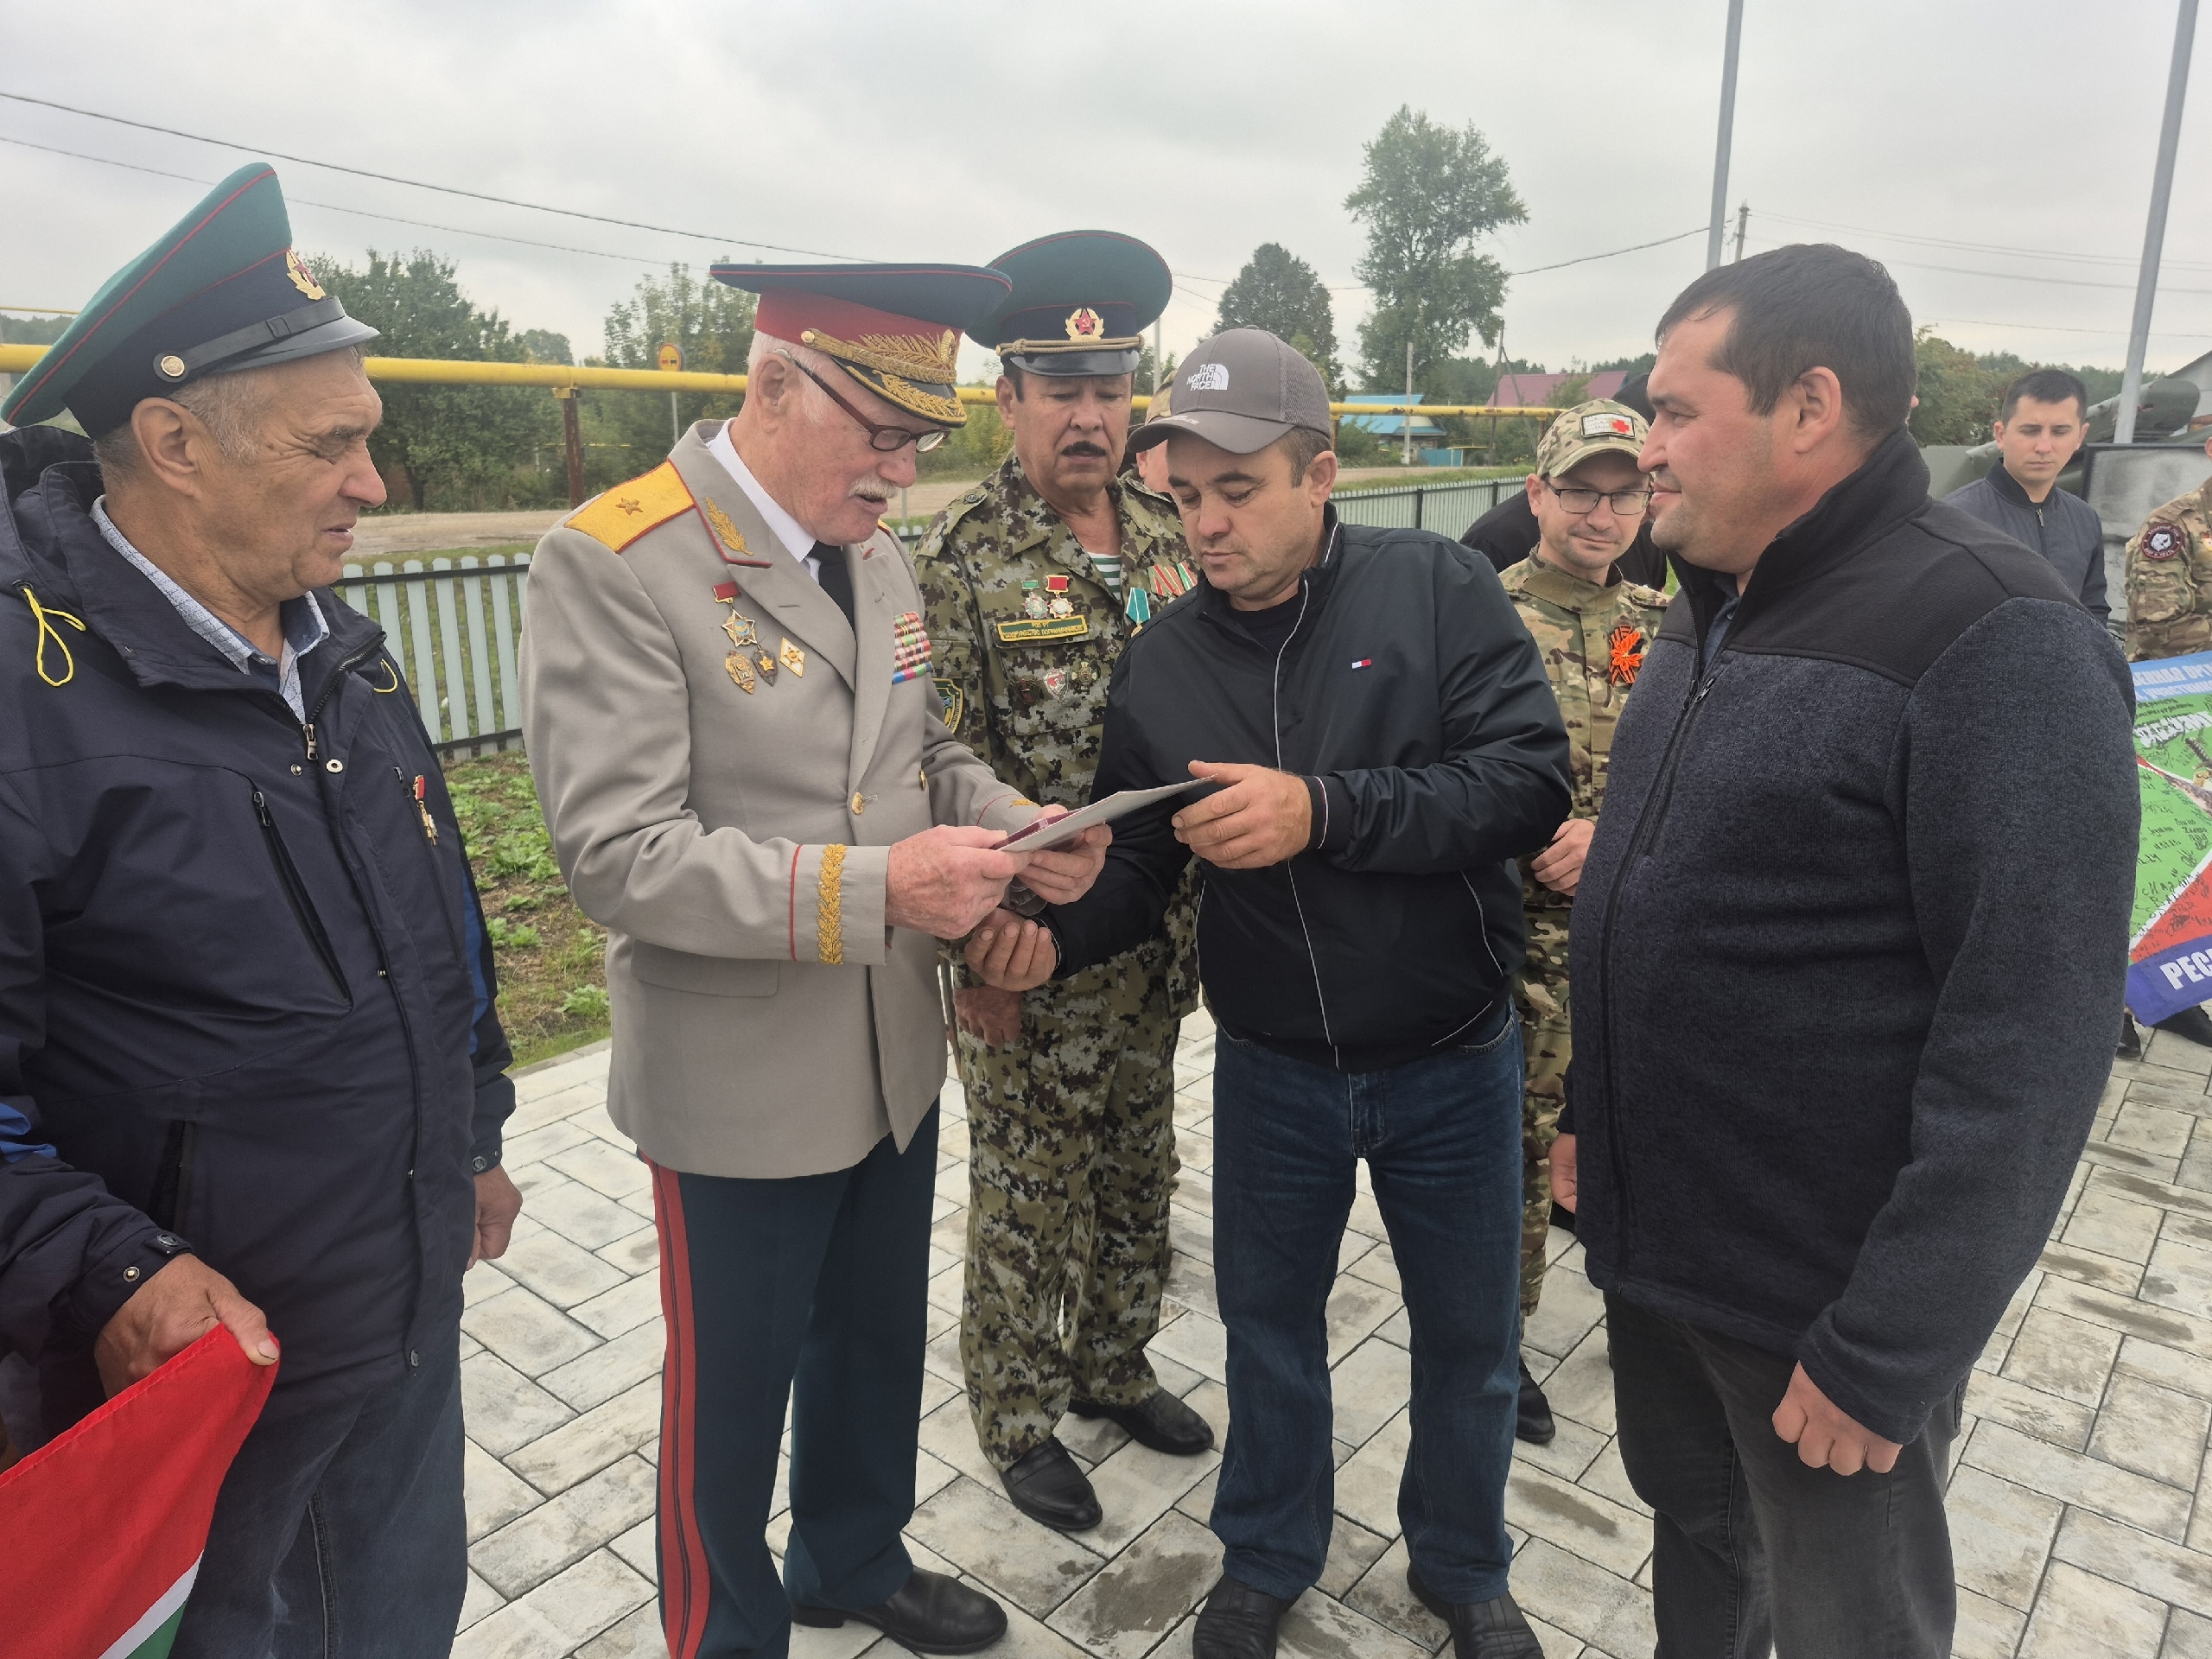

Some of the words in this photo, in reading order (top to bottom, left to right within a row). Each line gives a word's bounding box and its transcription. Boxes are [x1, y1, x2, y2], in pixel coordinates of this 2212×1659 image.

[1199, 364, 1216, 372] THE
[1186, 372, 1214, 385] NORTH
[1190, 380, 1212, 391] FACE
[2160, 948, 2212, 991] РЕС
